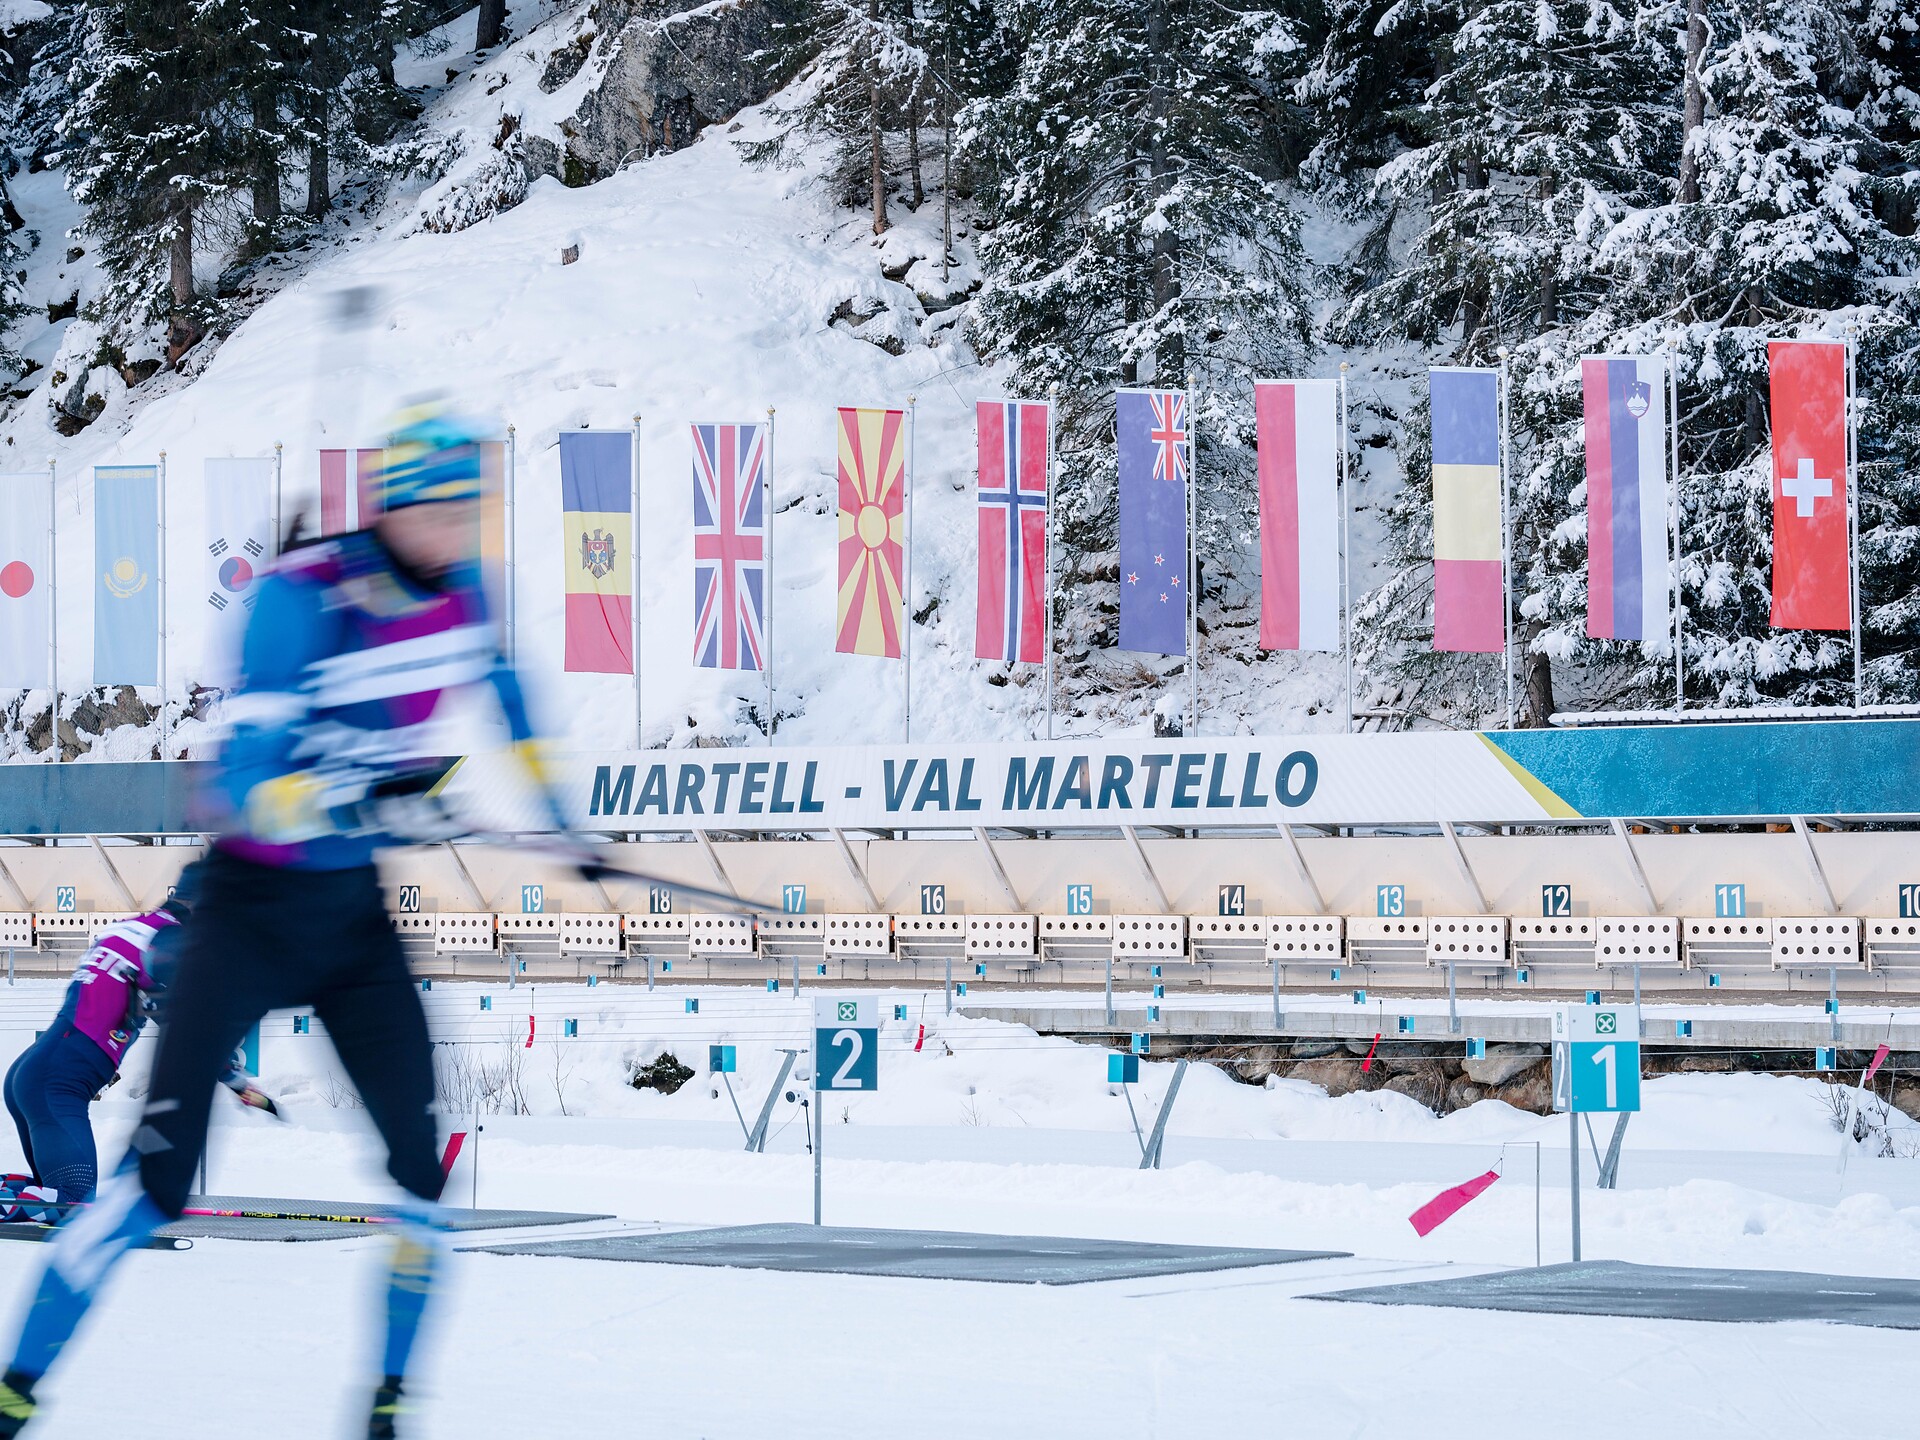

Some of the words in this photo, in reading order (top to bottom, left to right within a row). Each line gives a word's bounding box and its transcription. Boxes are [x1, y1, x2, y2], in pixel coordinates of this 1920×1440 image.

[589, 761, 824, 815] MARTELL
[844, 787, 861, 798] -
[883, 758, 982, 811] VAL
[1002, 751, 1318, 810] MARTELLO
[58, 888, 75, 911] 23
[401, 887, 420, 912] 20
[524, 887, 542, 912] 19
[652, 888, 671, 913] 18
[785, 886, 804, 912] 17
[923, 886, 944, 913] 16
[1070, 886, 1090, 914] 15
[1221, 887, 1243, 914] 14
[1380, 886, 1402, 915] 13
[1544, 886, 1569, 915] 12
[1718, 886, 1740, 915] 11
[831, 1029, 863, 1088] 2
[1556, 1042, 1565, 1106] 2
[1592, 1045, 1616, 1107] 1
